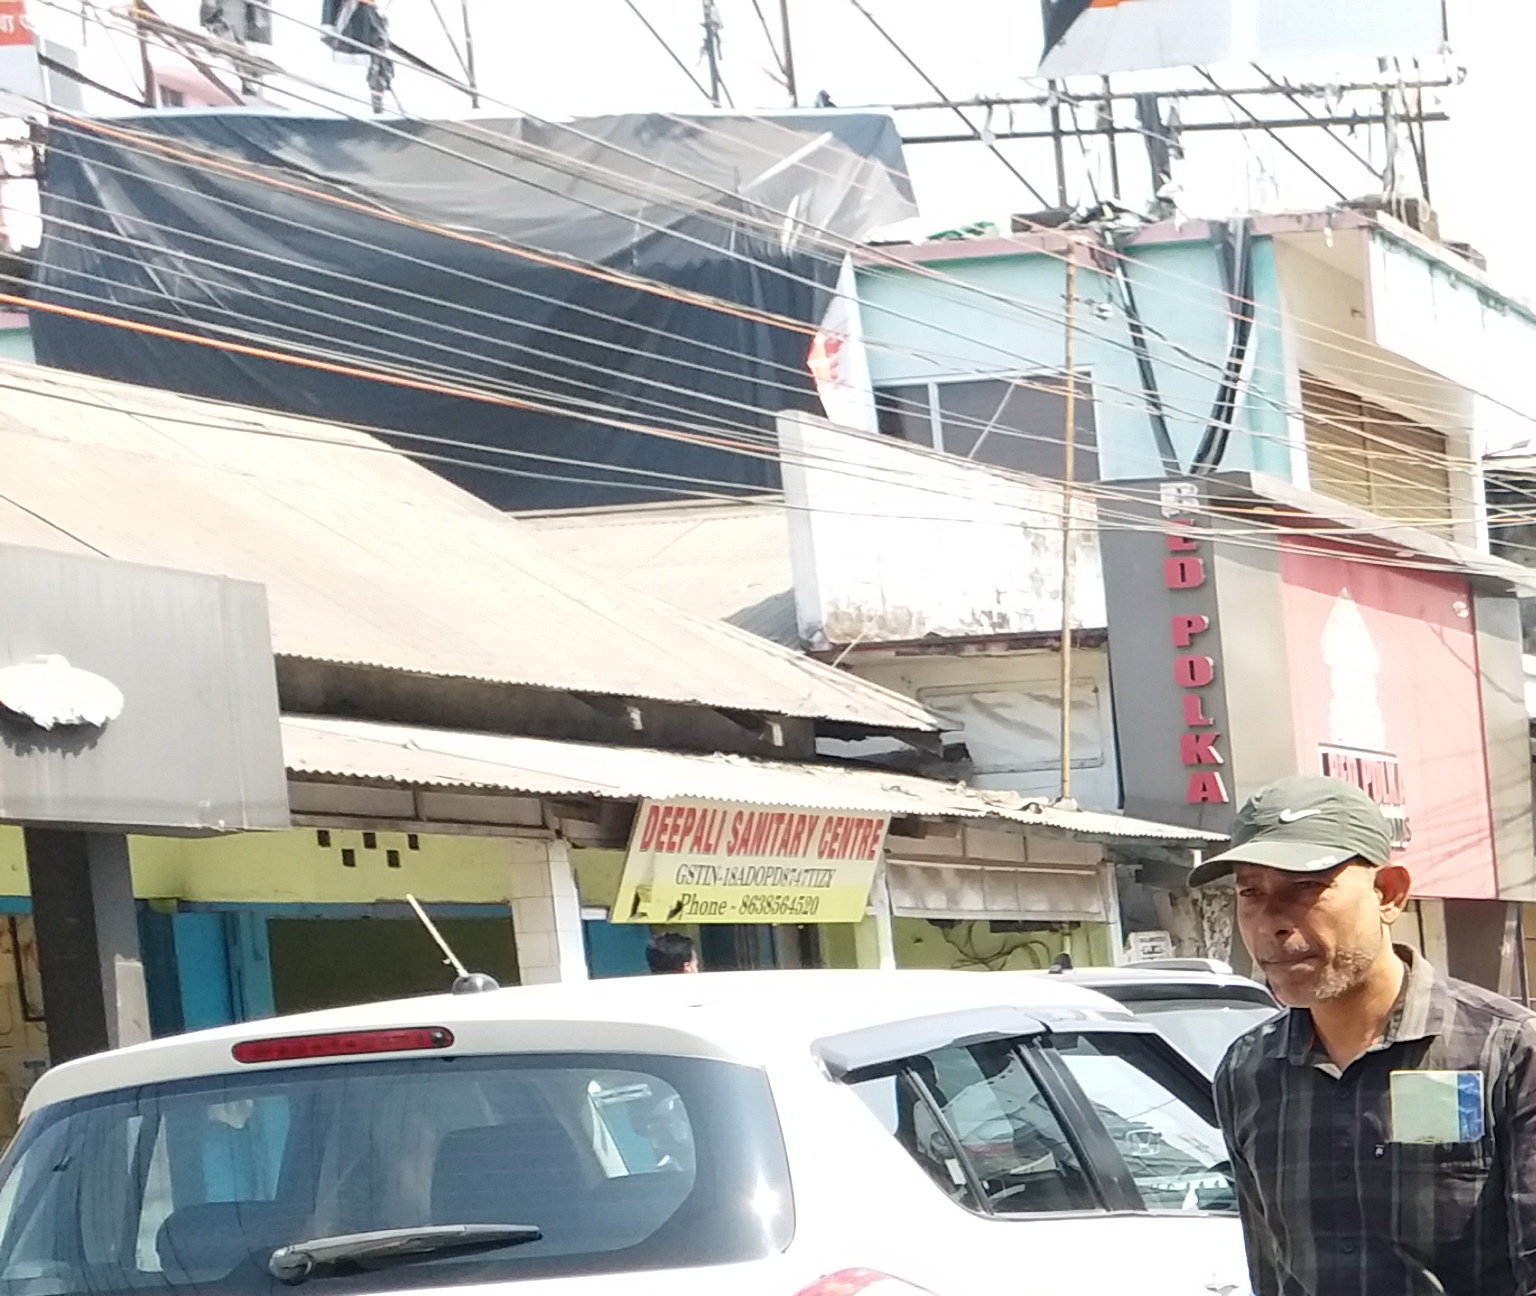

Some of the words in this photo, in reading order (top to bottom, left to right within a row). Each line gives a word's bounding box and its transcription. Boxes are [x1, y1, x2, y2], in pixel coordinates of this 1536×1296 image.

[1170, 614, 1229, 803] POLKA
[640, 805, 728, 855] DEEPALI
[726, 810, 820, 859] SANITARY
[817, 815, 884, 861] CENTRE
[681, 893, 727, 915] Phone
